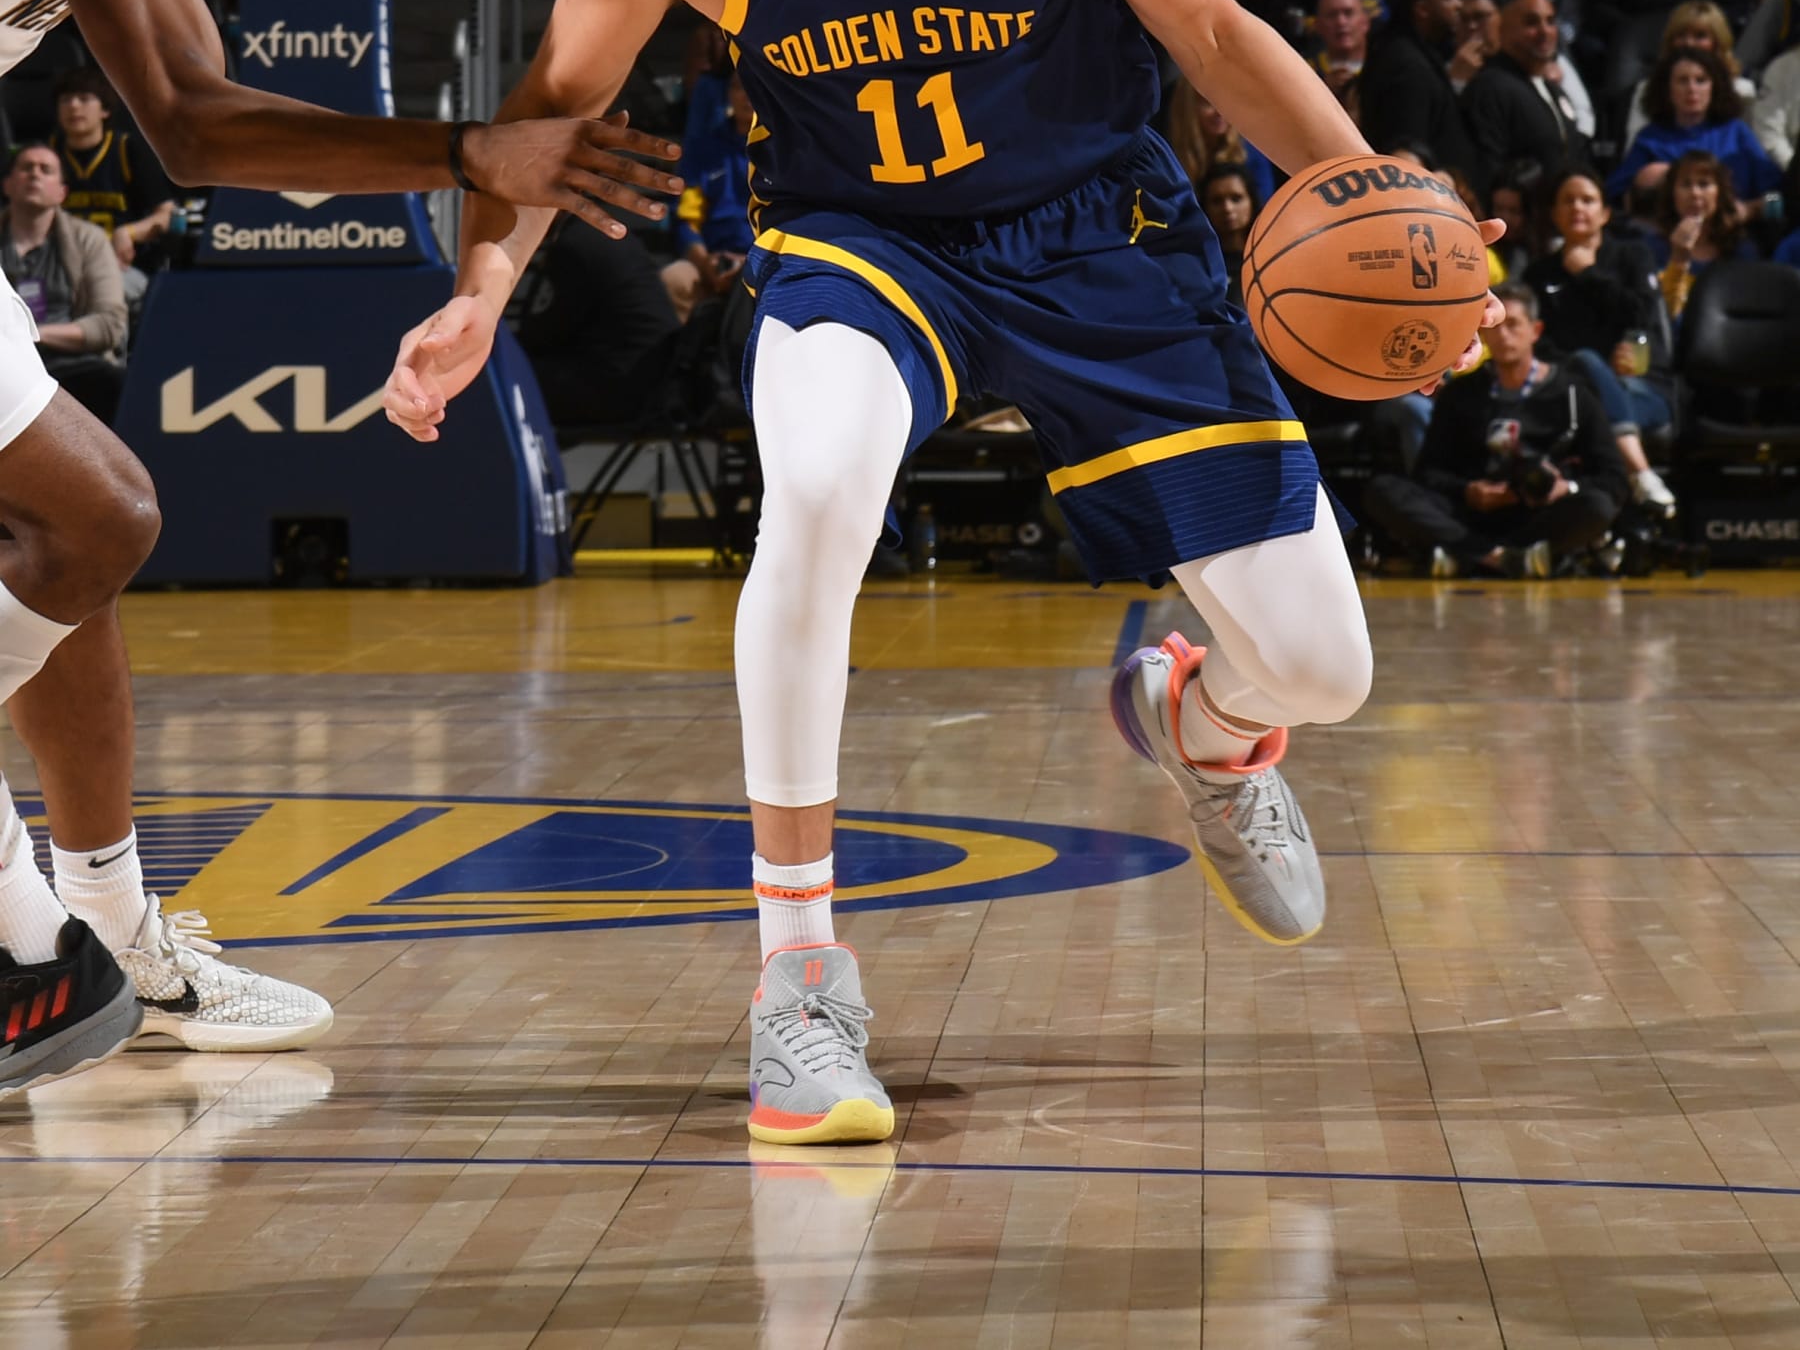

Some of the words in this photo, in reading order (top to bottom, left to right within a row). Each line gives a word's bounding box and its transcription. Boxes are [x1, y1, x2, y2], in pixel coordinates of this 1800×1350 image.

[243, 21, 374, 68] xfinity
[763, 10, 905, 77] GOLDEN
[912, 6, 1036, 54] STATE
[856, 71, 986, 184] 11
[212, 221, 407, 251] SentinelOne
[1705, 520, 1799, 540] CHASE
